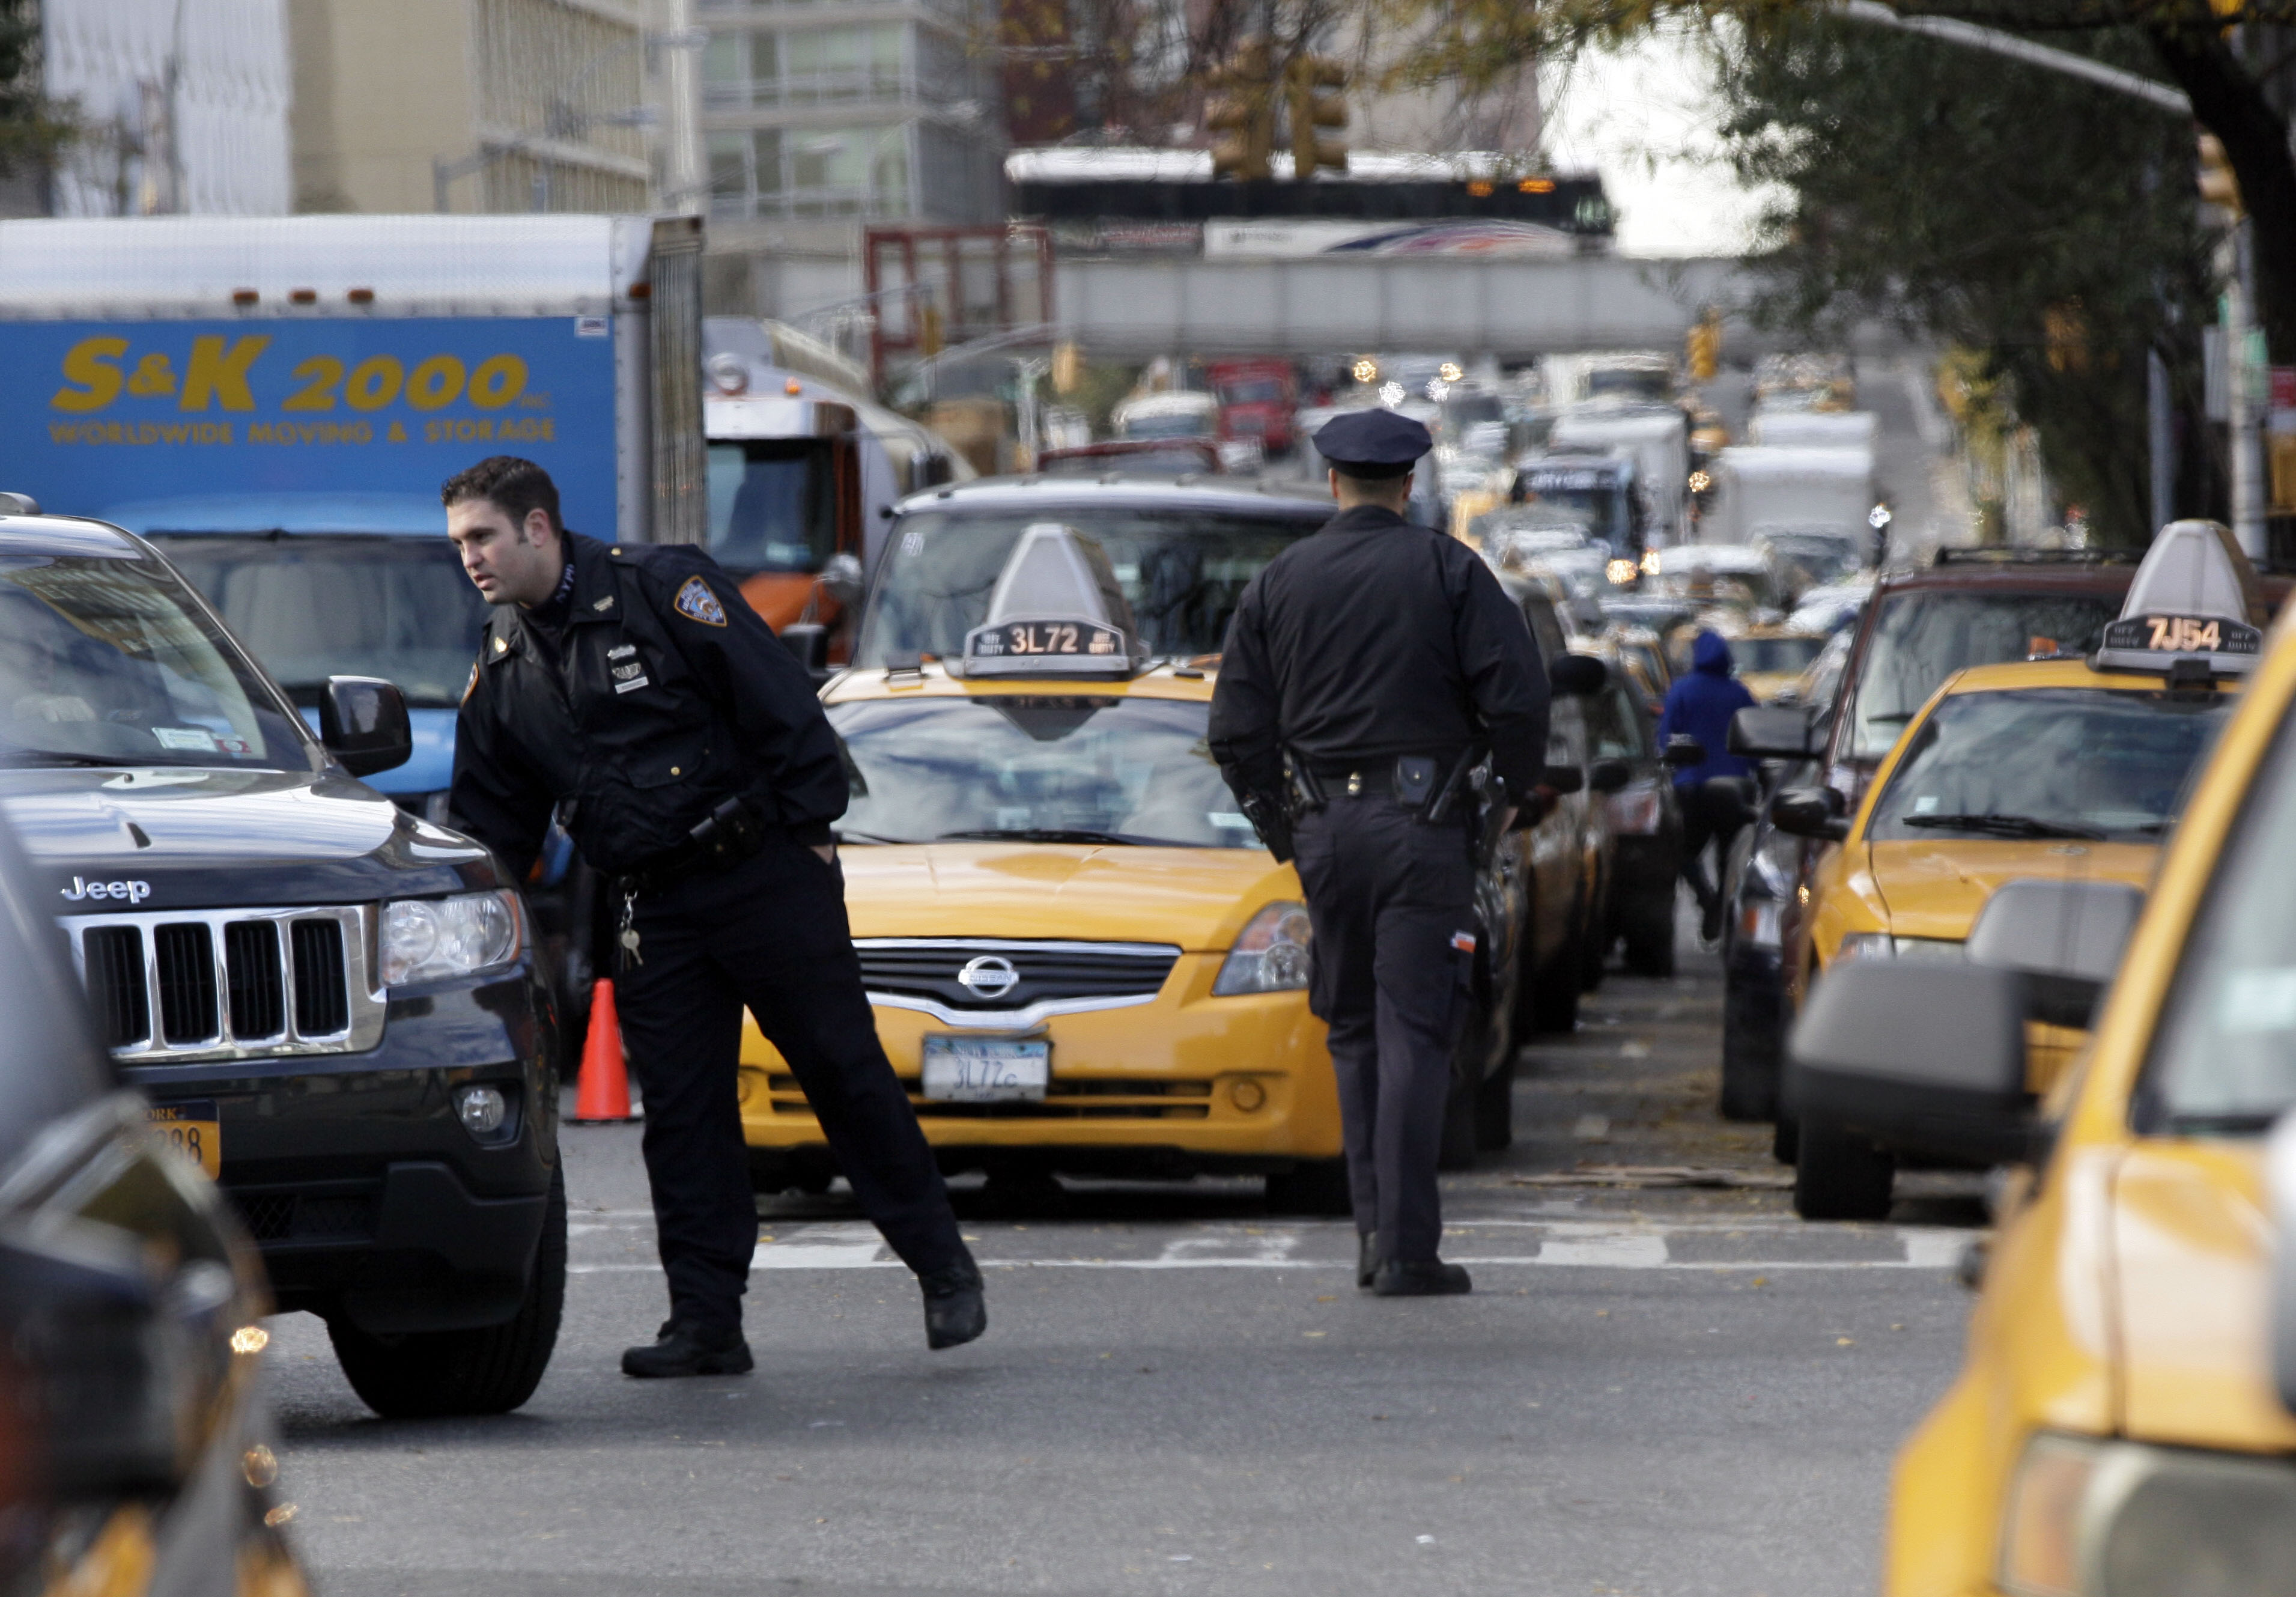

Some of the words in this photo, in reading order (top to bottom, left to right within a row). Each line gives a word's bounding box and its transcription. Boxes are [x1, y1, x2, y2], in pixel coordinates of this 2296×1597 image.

[50, 334, 272, 412] S&K
[282, 354, 529, 412] 2000
[49, 423, 232, 445] WORLDWIDE
[248, 422, 373, 445] MOVING
[387, 422, 407, 442] &
[424, 419, 556, 443] STORAGE
[1010, 625, 1078, 653] 3L72
[2146, 617, 2222, 651] 7J54
[61, 876, 150, 904] Jeep
